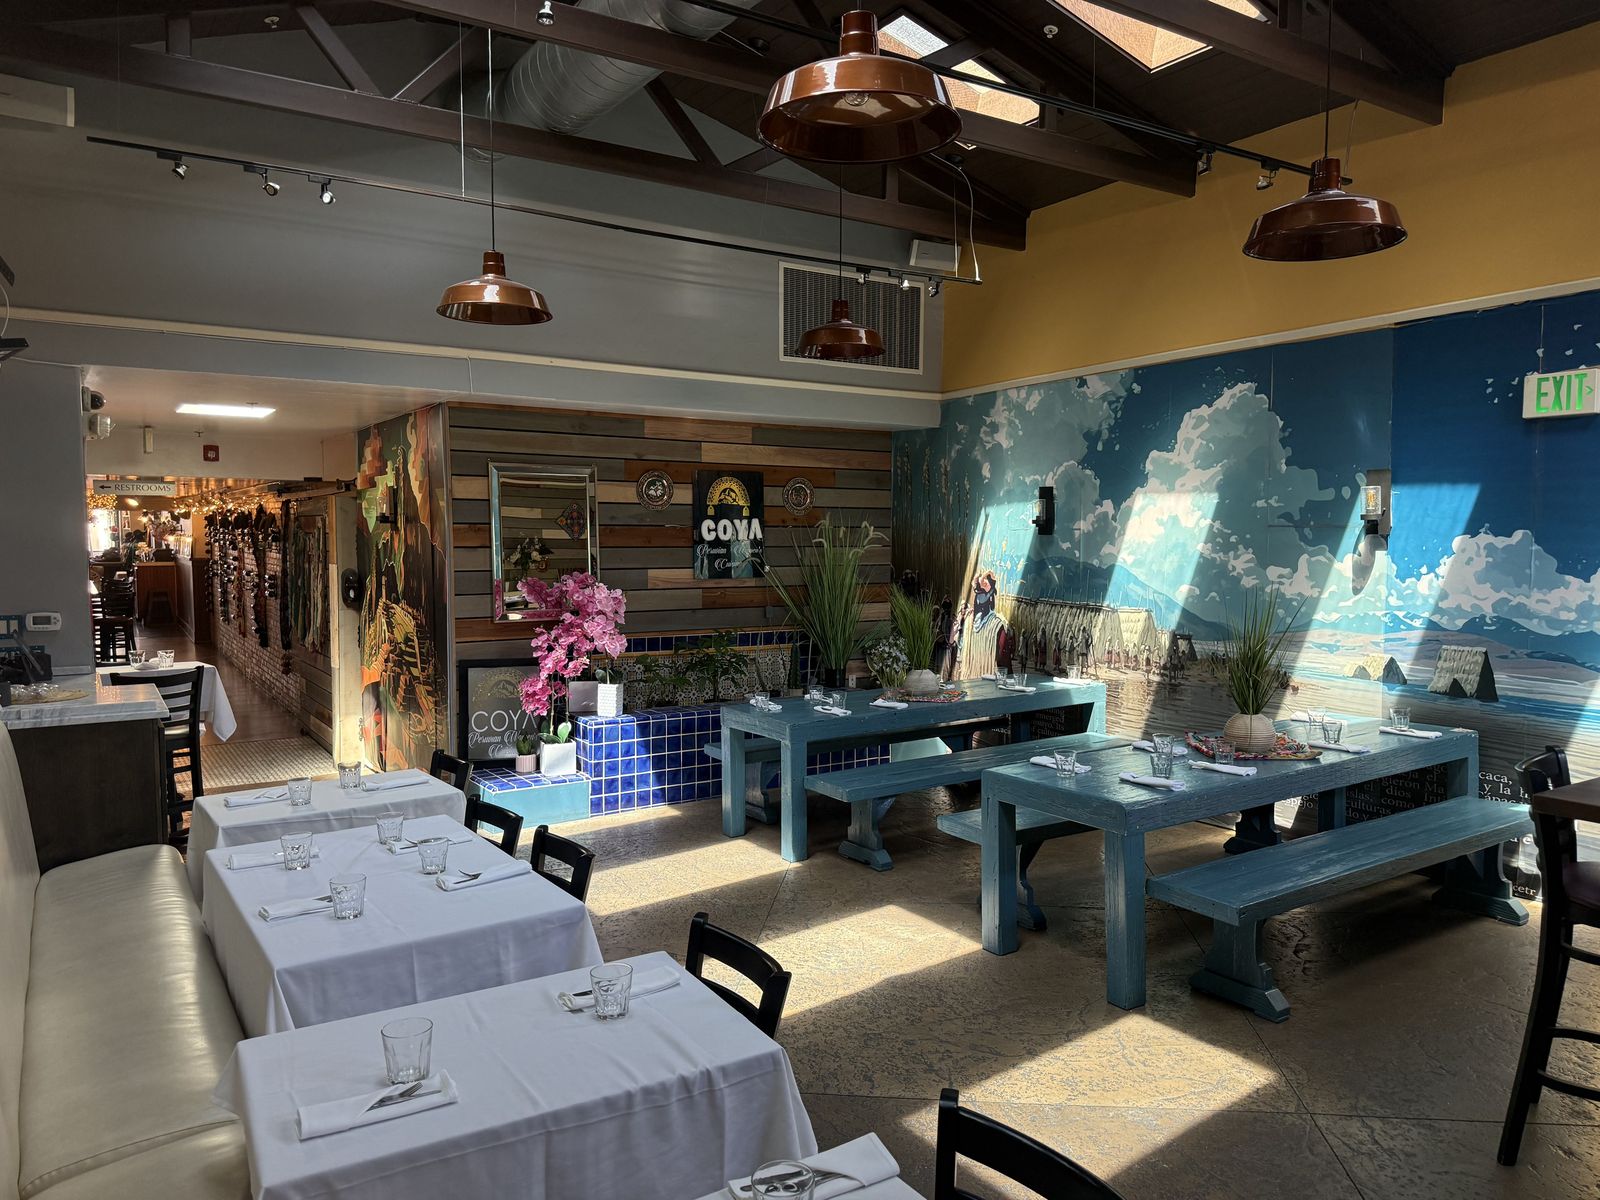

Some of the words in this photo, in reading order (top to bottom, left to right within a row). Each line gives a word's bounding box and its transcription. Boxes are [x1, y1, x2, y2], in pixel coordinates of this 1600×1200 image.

[1536, 373, 1588, 413] EXIT
[114, 484, 171, 492] RESTROOMS
[700, 517, 763, 541] COYA
[471, 710, 537, 732] COYA
[1381, 776, 1420, 790] gieron
[1484, 783, 1491, 794] y
[1499, 783, 1512, 795] la
[1386, 785, 1412, 798] dios
